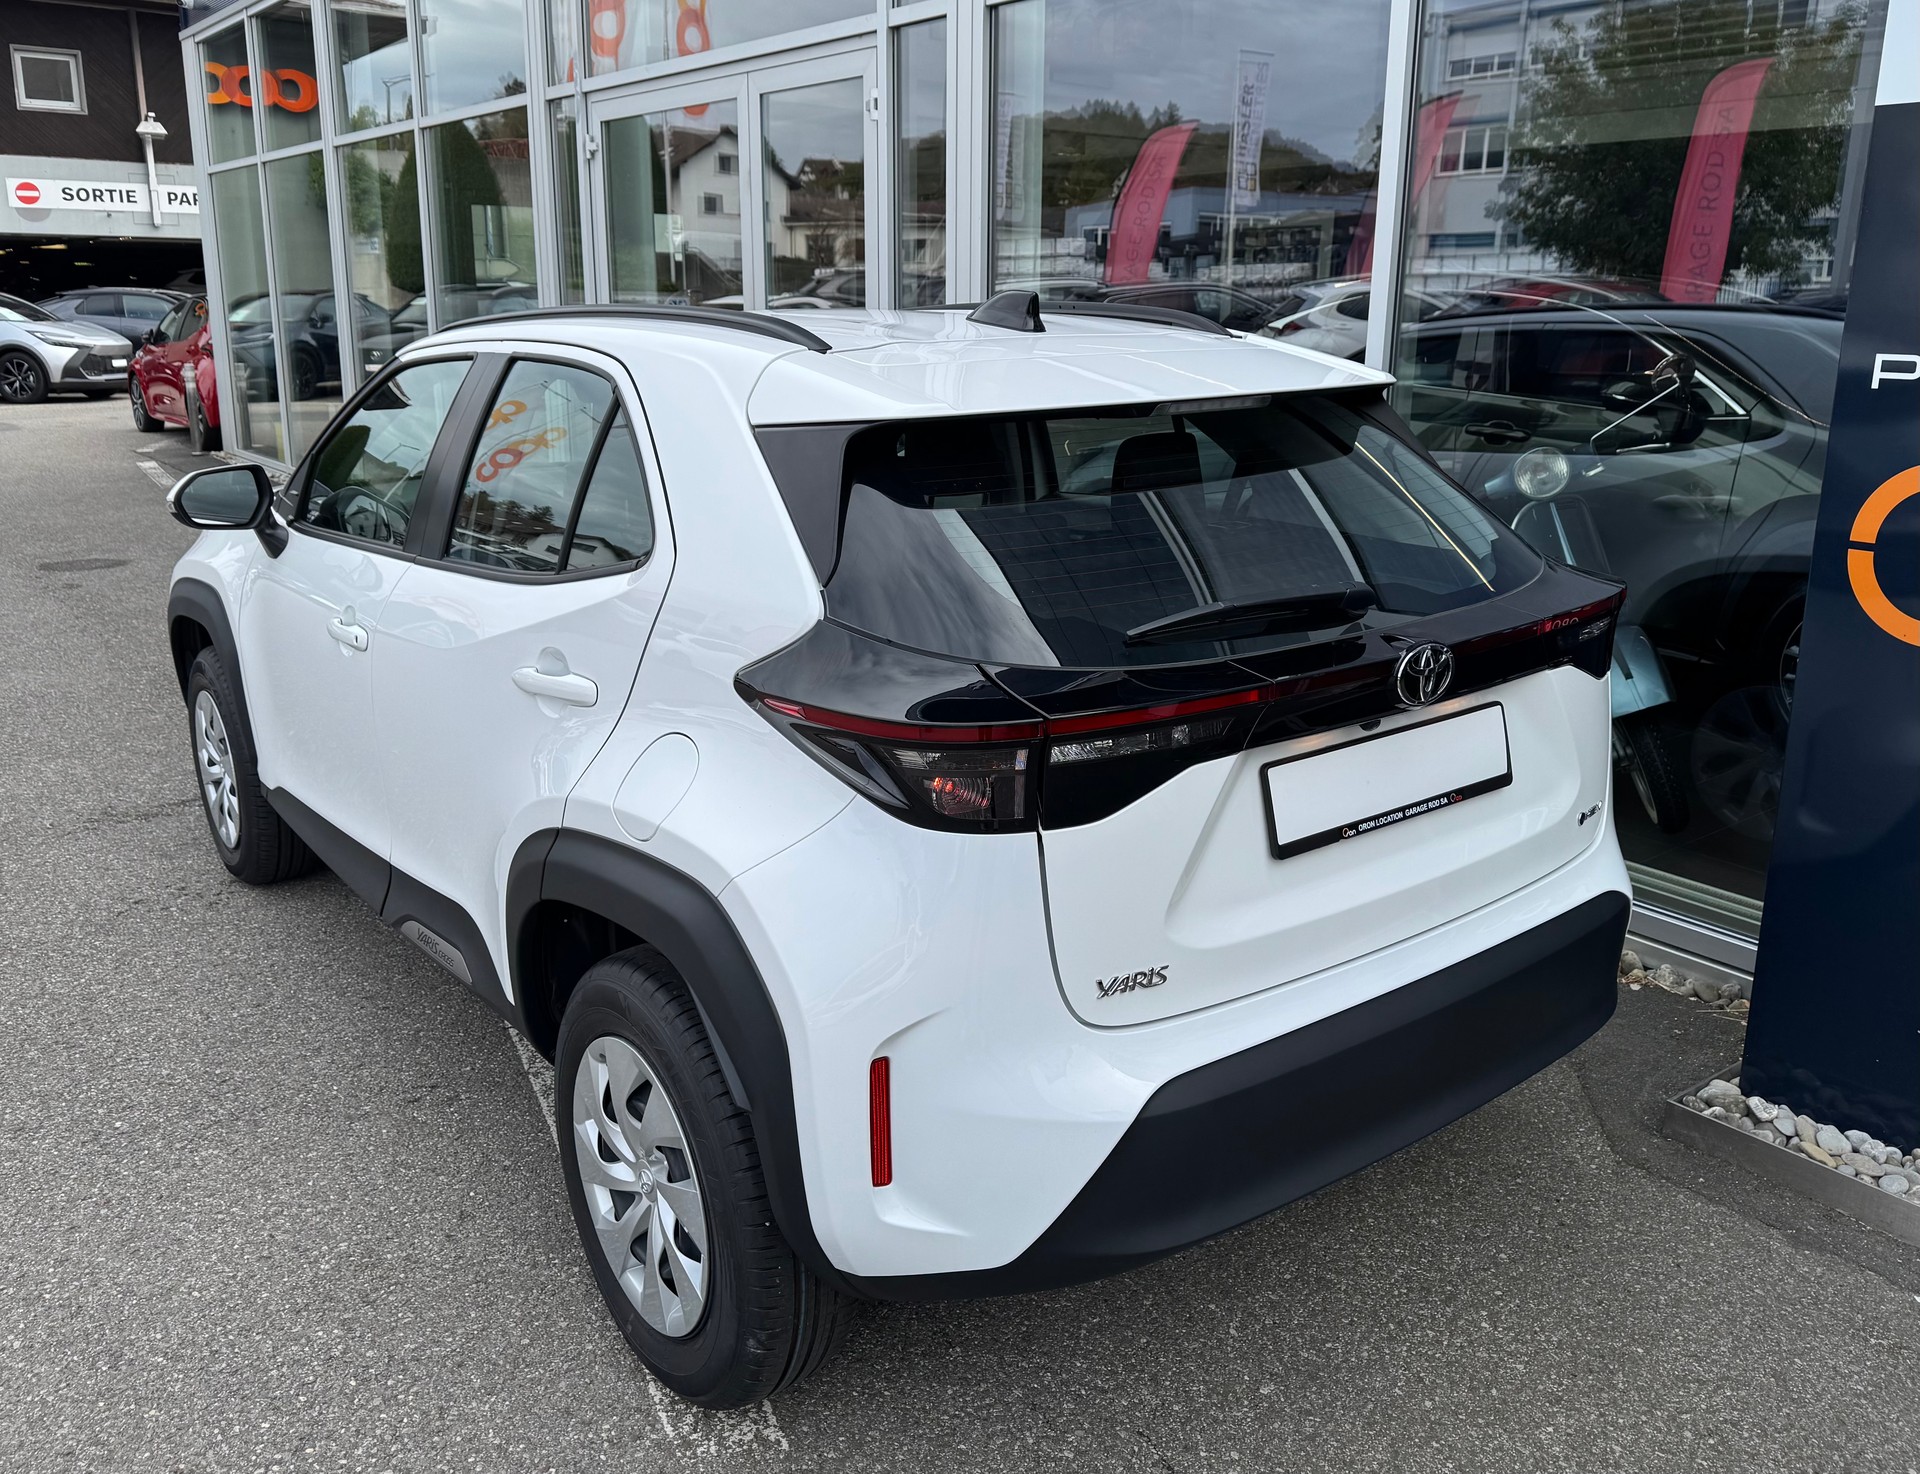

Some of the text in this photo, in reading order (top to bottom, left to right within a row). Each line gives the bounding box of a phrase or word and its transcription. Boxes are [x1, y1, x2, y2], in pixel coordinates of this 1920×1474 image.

[1697, 150, 1724, 212] ROD
[1714, 106, 1735, 146] SA
[61, 187, 138, 204] SORTIE
[1134, 186, 1156, 232] ROD
[1149, 155, 1167, 179] SA
[1358, 820, 1376, 832] ORON
[1376, 811, 1403, 826] LOCATION
[1404, 803, 1428, 817] GARAGE
[1428, 799, 1440, 809] ROD
[1440, 796, 1449, 805] SA
